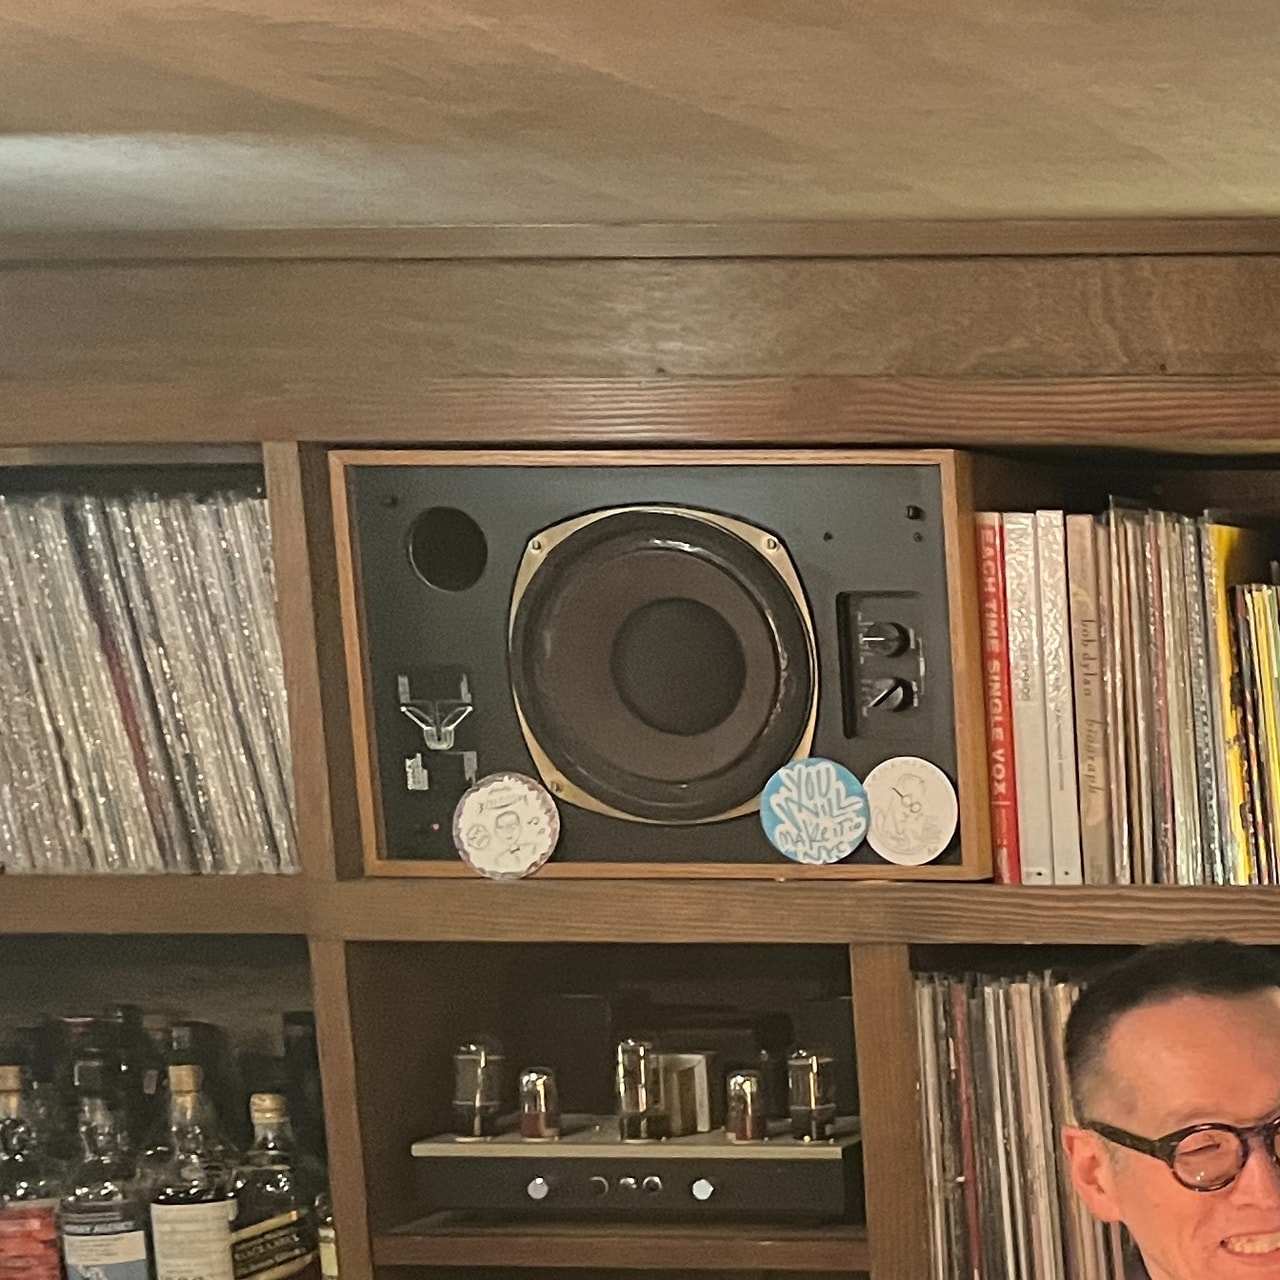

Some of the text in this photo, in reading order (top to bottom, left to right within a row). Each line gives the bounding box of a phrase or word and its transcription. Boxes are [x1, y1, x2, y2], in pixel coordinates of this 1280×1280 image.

[979, 523, 995, 594] EACH
[982, 600, 999, 652] TIME
[985, 658, 1005, 739] SINGLE
[1079, 617, 1104, 796] bob dylan biograph
[783, 765, 832, 800] YOU
[991, 746, 1008, 802] VOX
[776, 788, 863, 830] WILL
